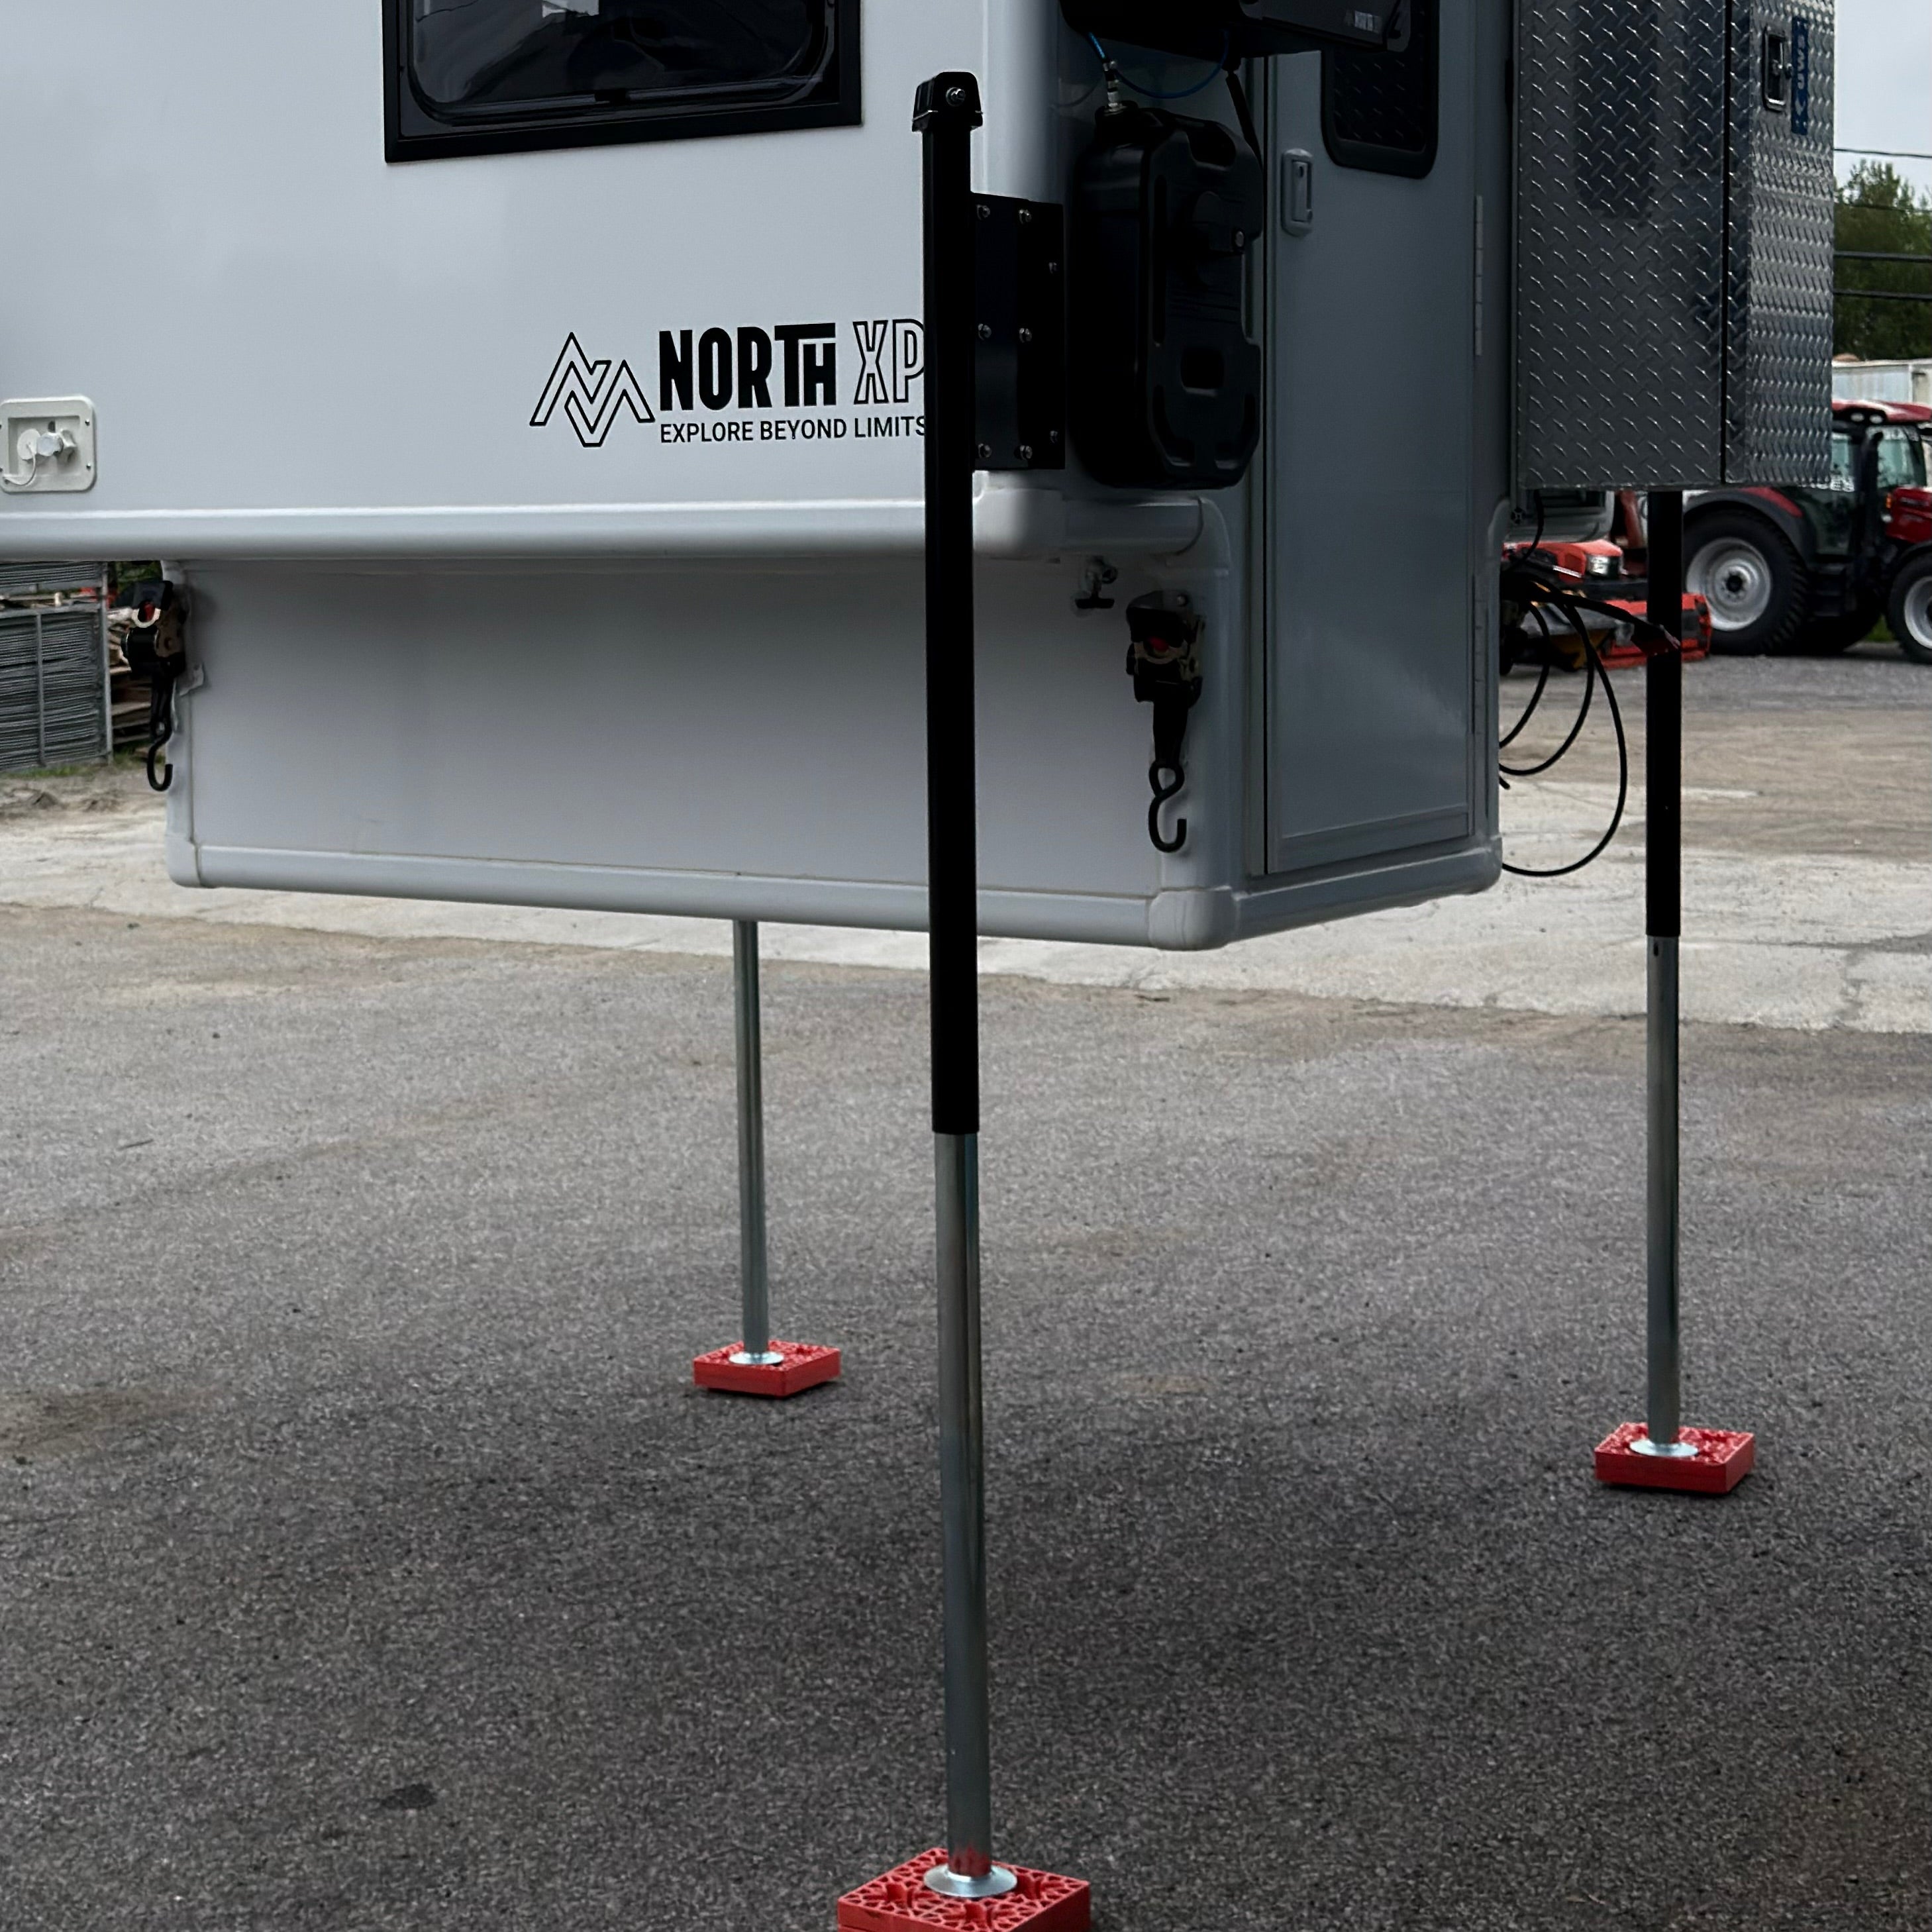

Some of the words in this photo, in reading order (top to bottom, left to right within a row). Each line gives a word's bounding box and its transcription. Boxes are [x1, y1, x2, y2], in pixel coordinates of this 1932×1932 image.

[659, 322, 837, 411] NORTH
[660, 420, 753, 443] EXPLORE
[760, 418, 846, 440] BEYOND
